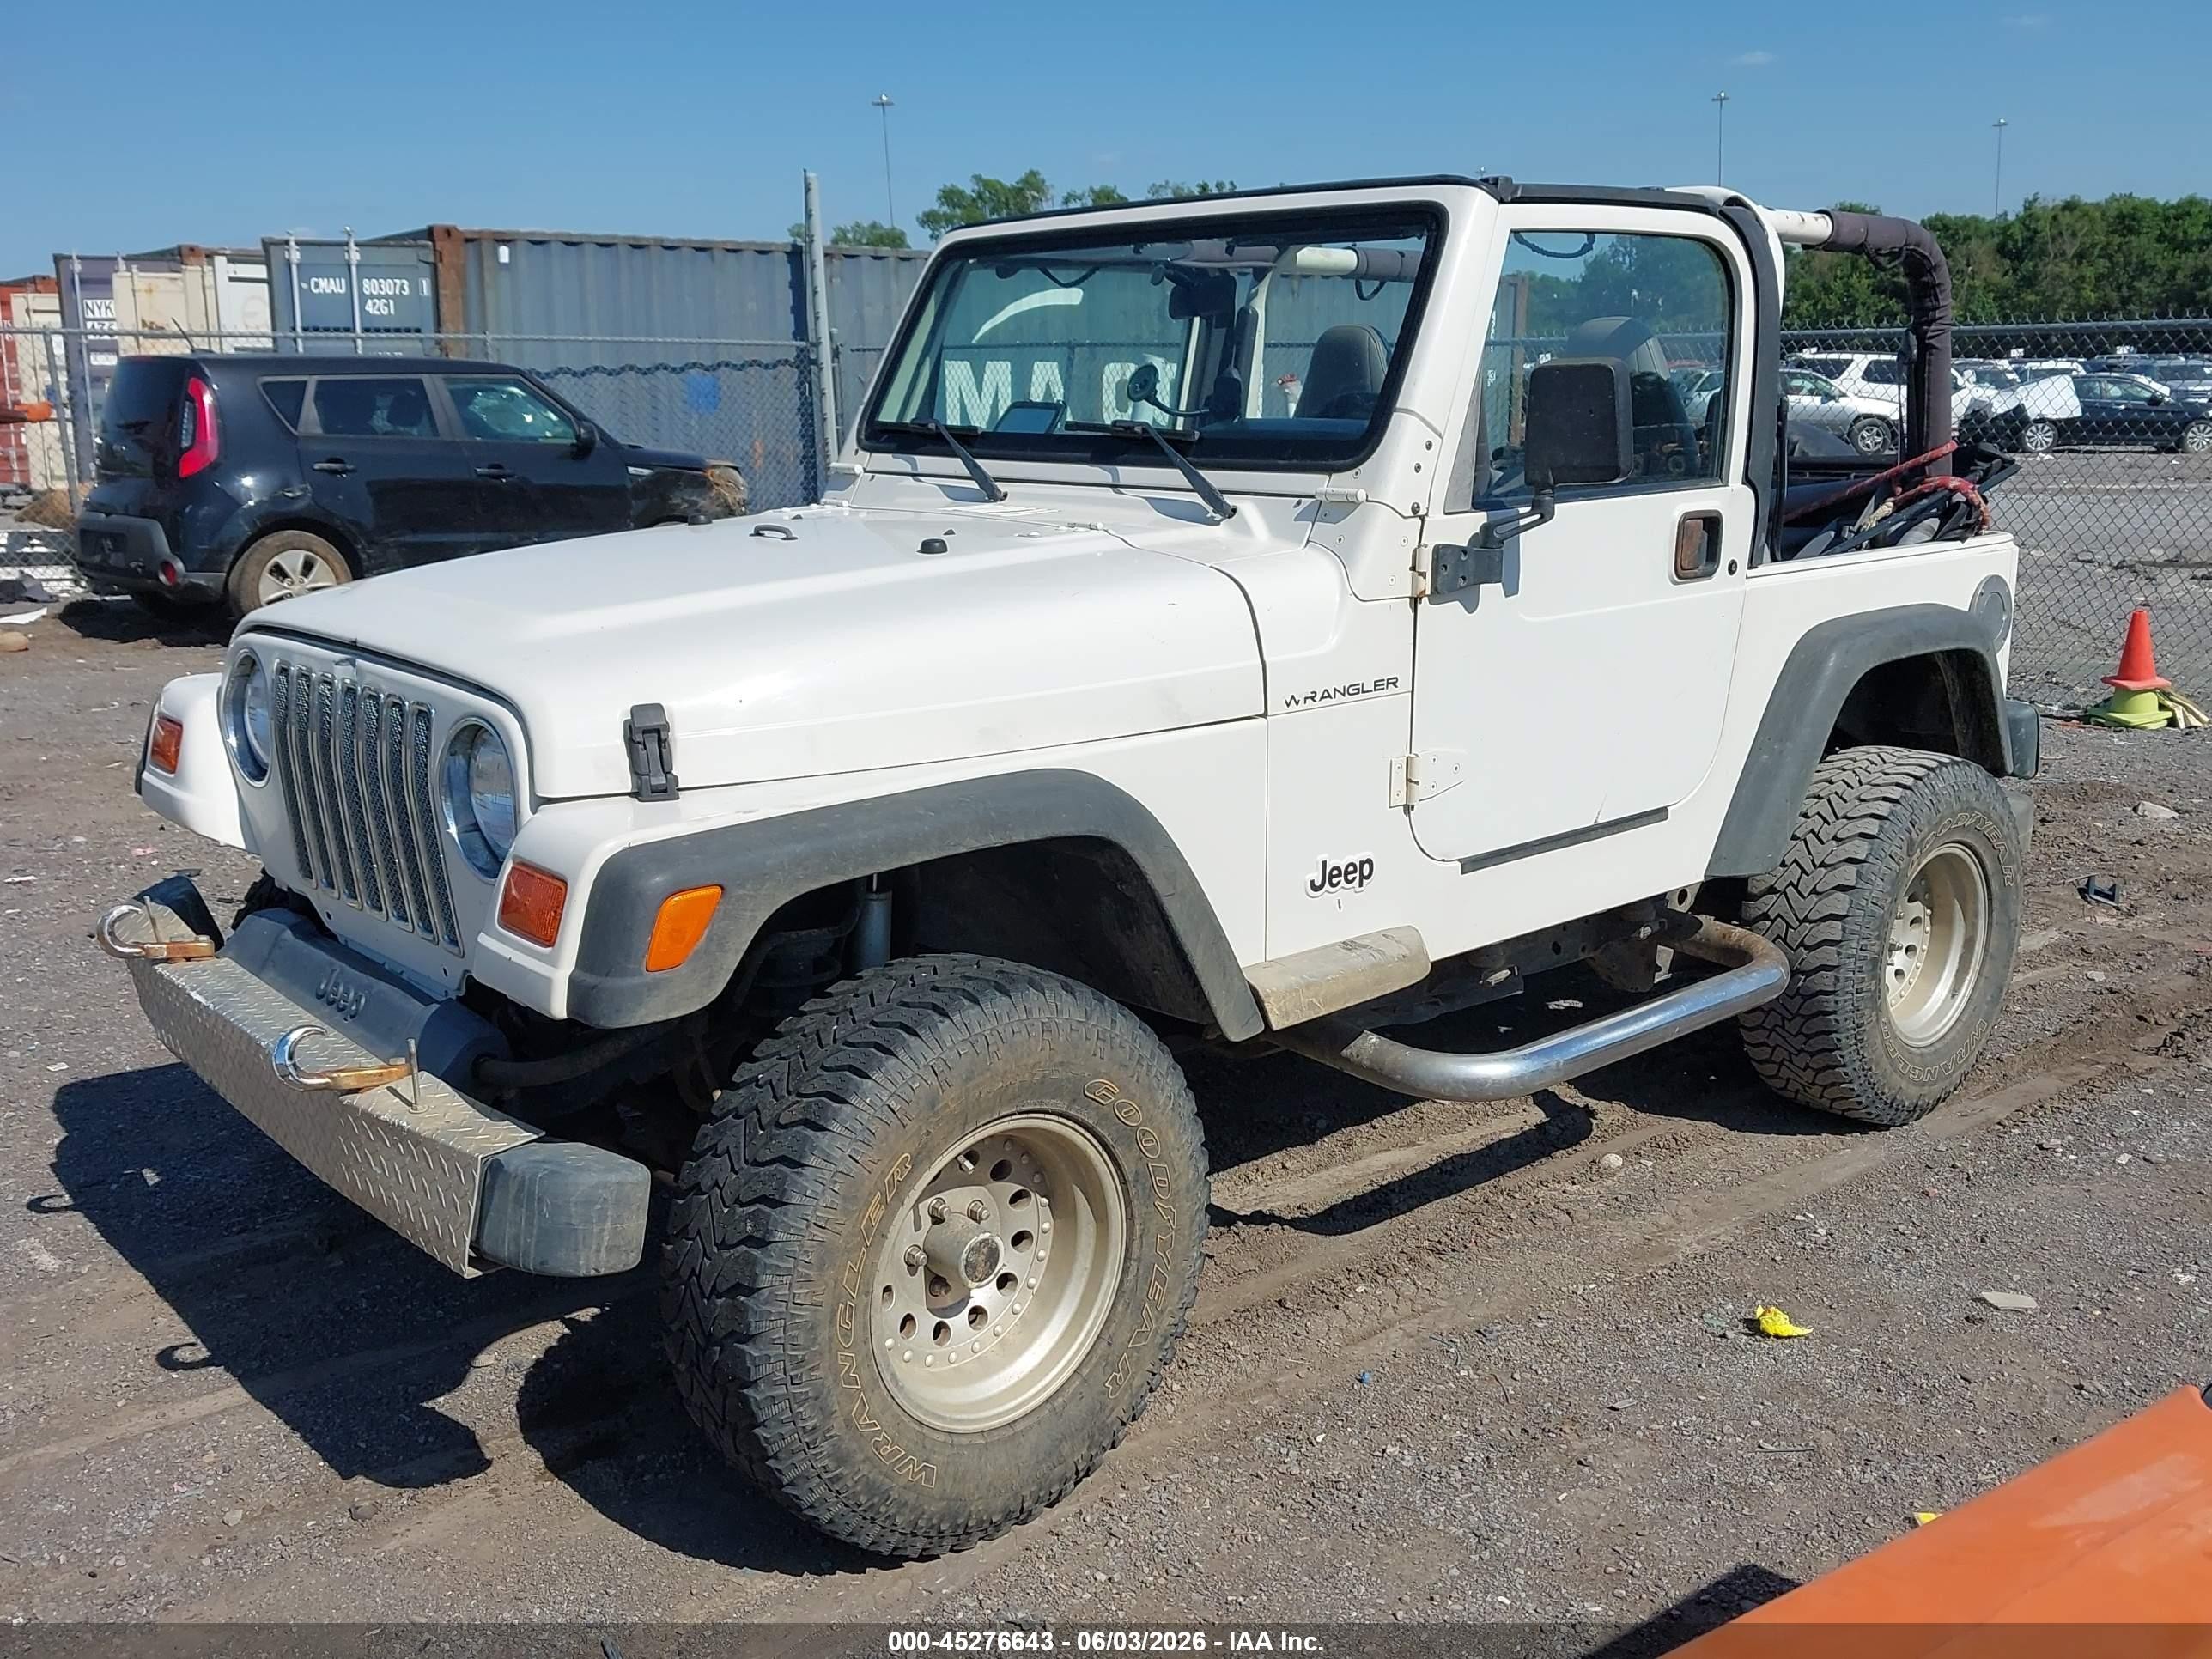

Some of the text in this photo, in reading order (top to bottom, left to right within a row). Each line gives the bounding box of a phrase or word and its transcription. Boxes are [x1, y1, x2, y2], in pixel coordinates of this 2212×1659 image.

[310, 276, 346, 295] CMAU
[362, 278, 410, 296] 803073
[364, 298, 395, 316] 42G1
[1284, 676, 1400, 708] WRANGLER
[1310, 857, 1374, 892] Jeep
[315, 968, 367, 1023] Jeep
[1084, 1079, 1176, 1399] GOODYEAR
[837, 1152, 938, 1488] WRANGLER
